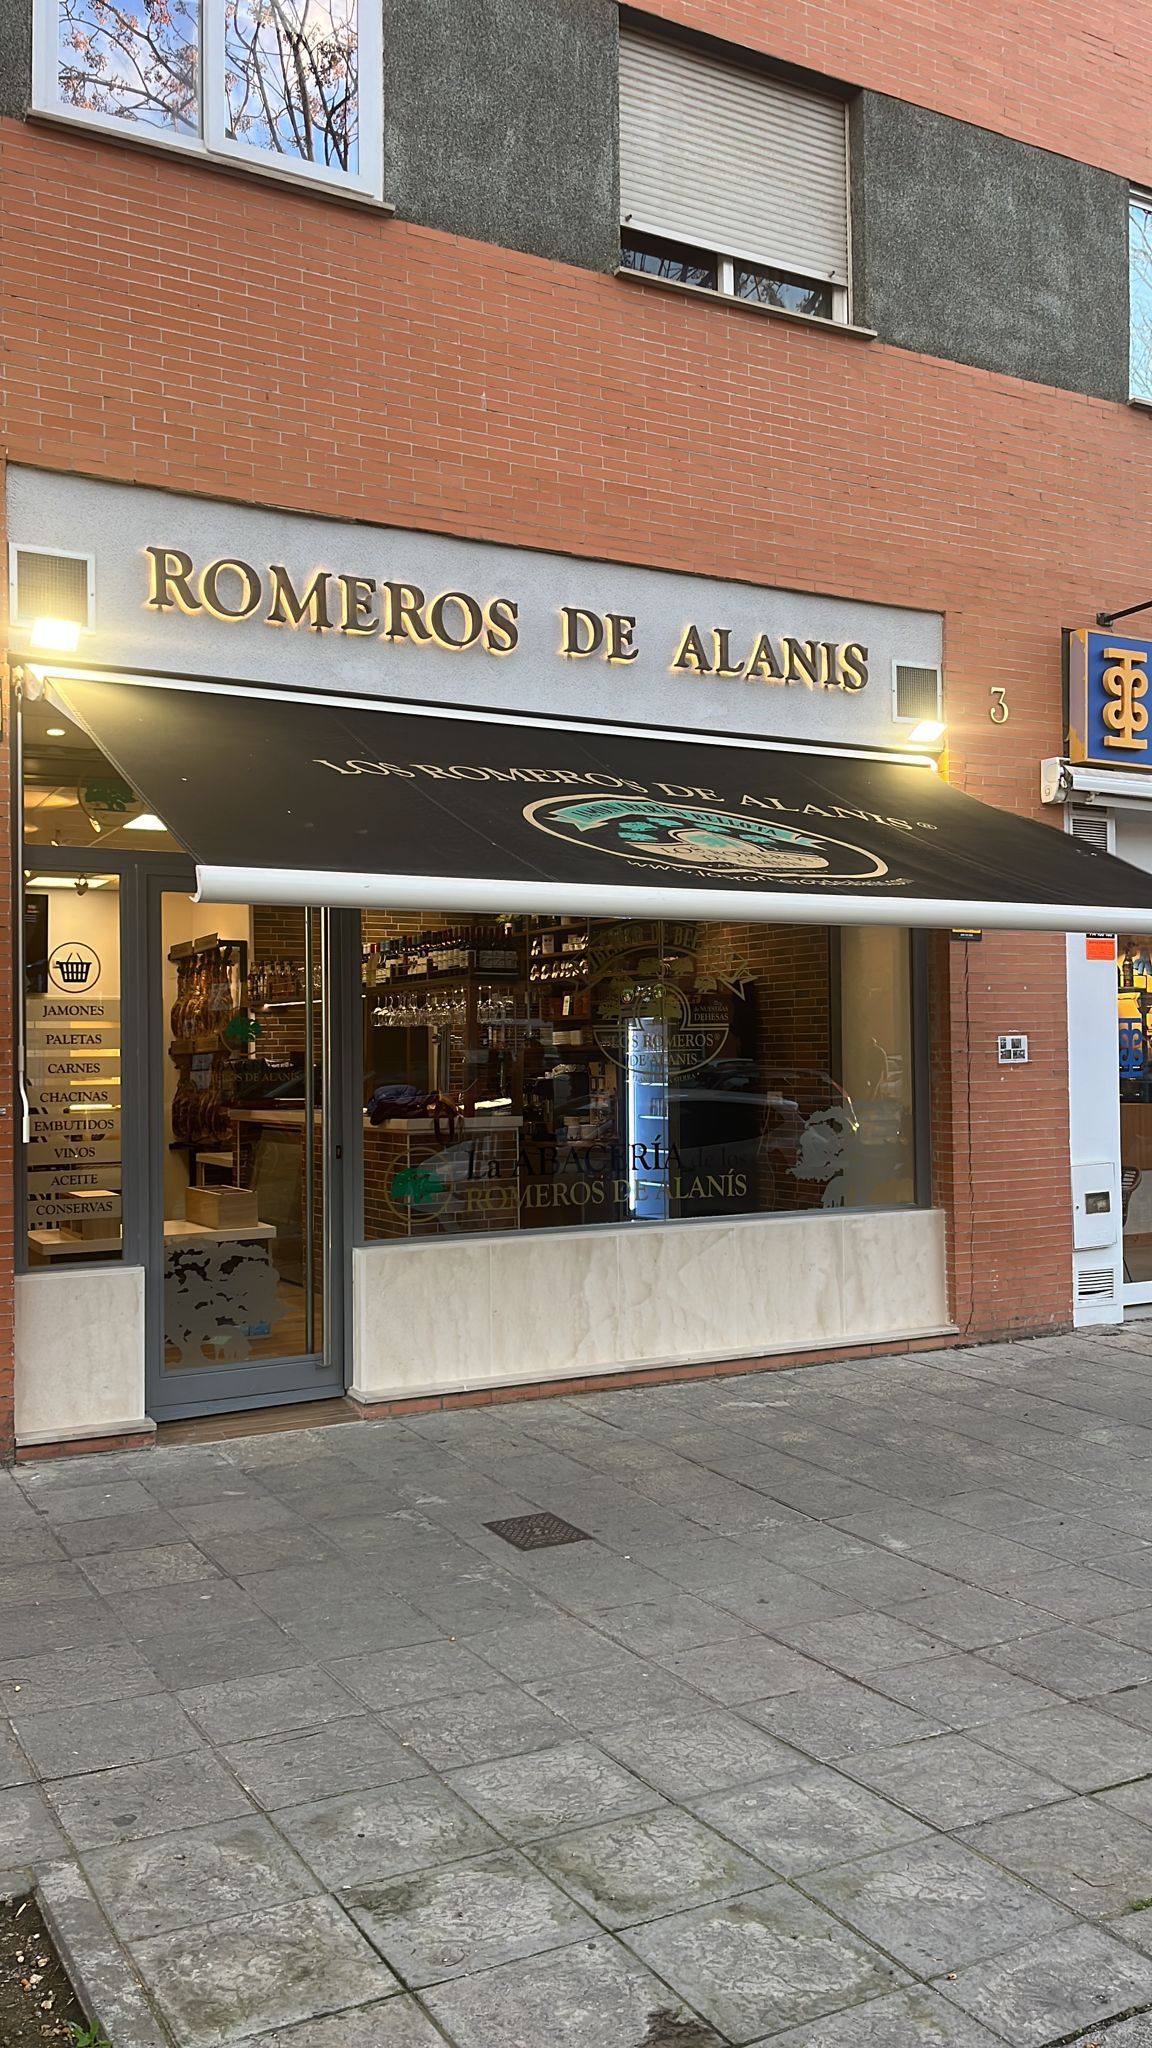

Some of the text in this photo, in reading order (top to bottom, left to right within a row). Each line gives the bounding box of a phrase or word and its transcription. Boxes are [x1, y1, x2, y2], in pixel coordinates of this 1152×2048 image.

[144, 546, 870, 690] ROMEROS DE ALANIS
[989, 686, 1009, 724] 3
[312, 758, 416, 779] LOS
[410, 763, 648, 794] ROMEROS
[652, 781, 725, 803] DE
[690, 812, 778, 836] BELLOTA
[42, 1004, 104, 1018] JAMONES
[693, 1012, 729, 1022] DEHESAS
[45, 1032, 103, 1046] PALETAS
[629, 1053, 699, 1067] DE ALANIS
[47, 1061, 101, 1075] CARNES
[39, 1089, 109, 1104] CHACINAS
[34, 1117, 114, 1133] EMBUTIDOS
[54, 1145, 96, 1159] VINOS
[466, 1147, 502, 1180] La
[50, 1173, 98, 1187] ACEITE
[466, 1168, 748, 1211] ROMEROS DE ALANÍS
[35, 1200, 113, 1216] CONSERVAS
